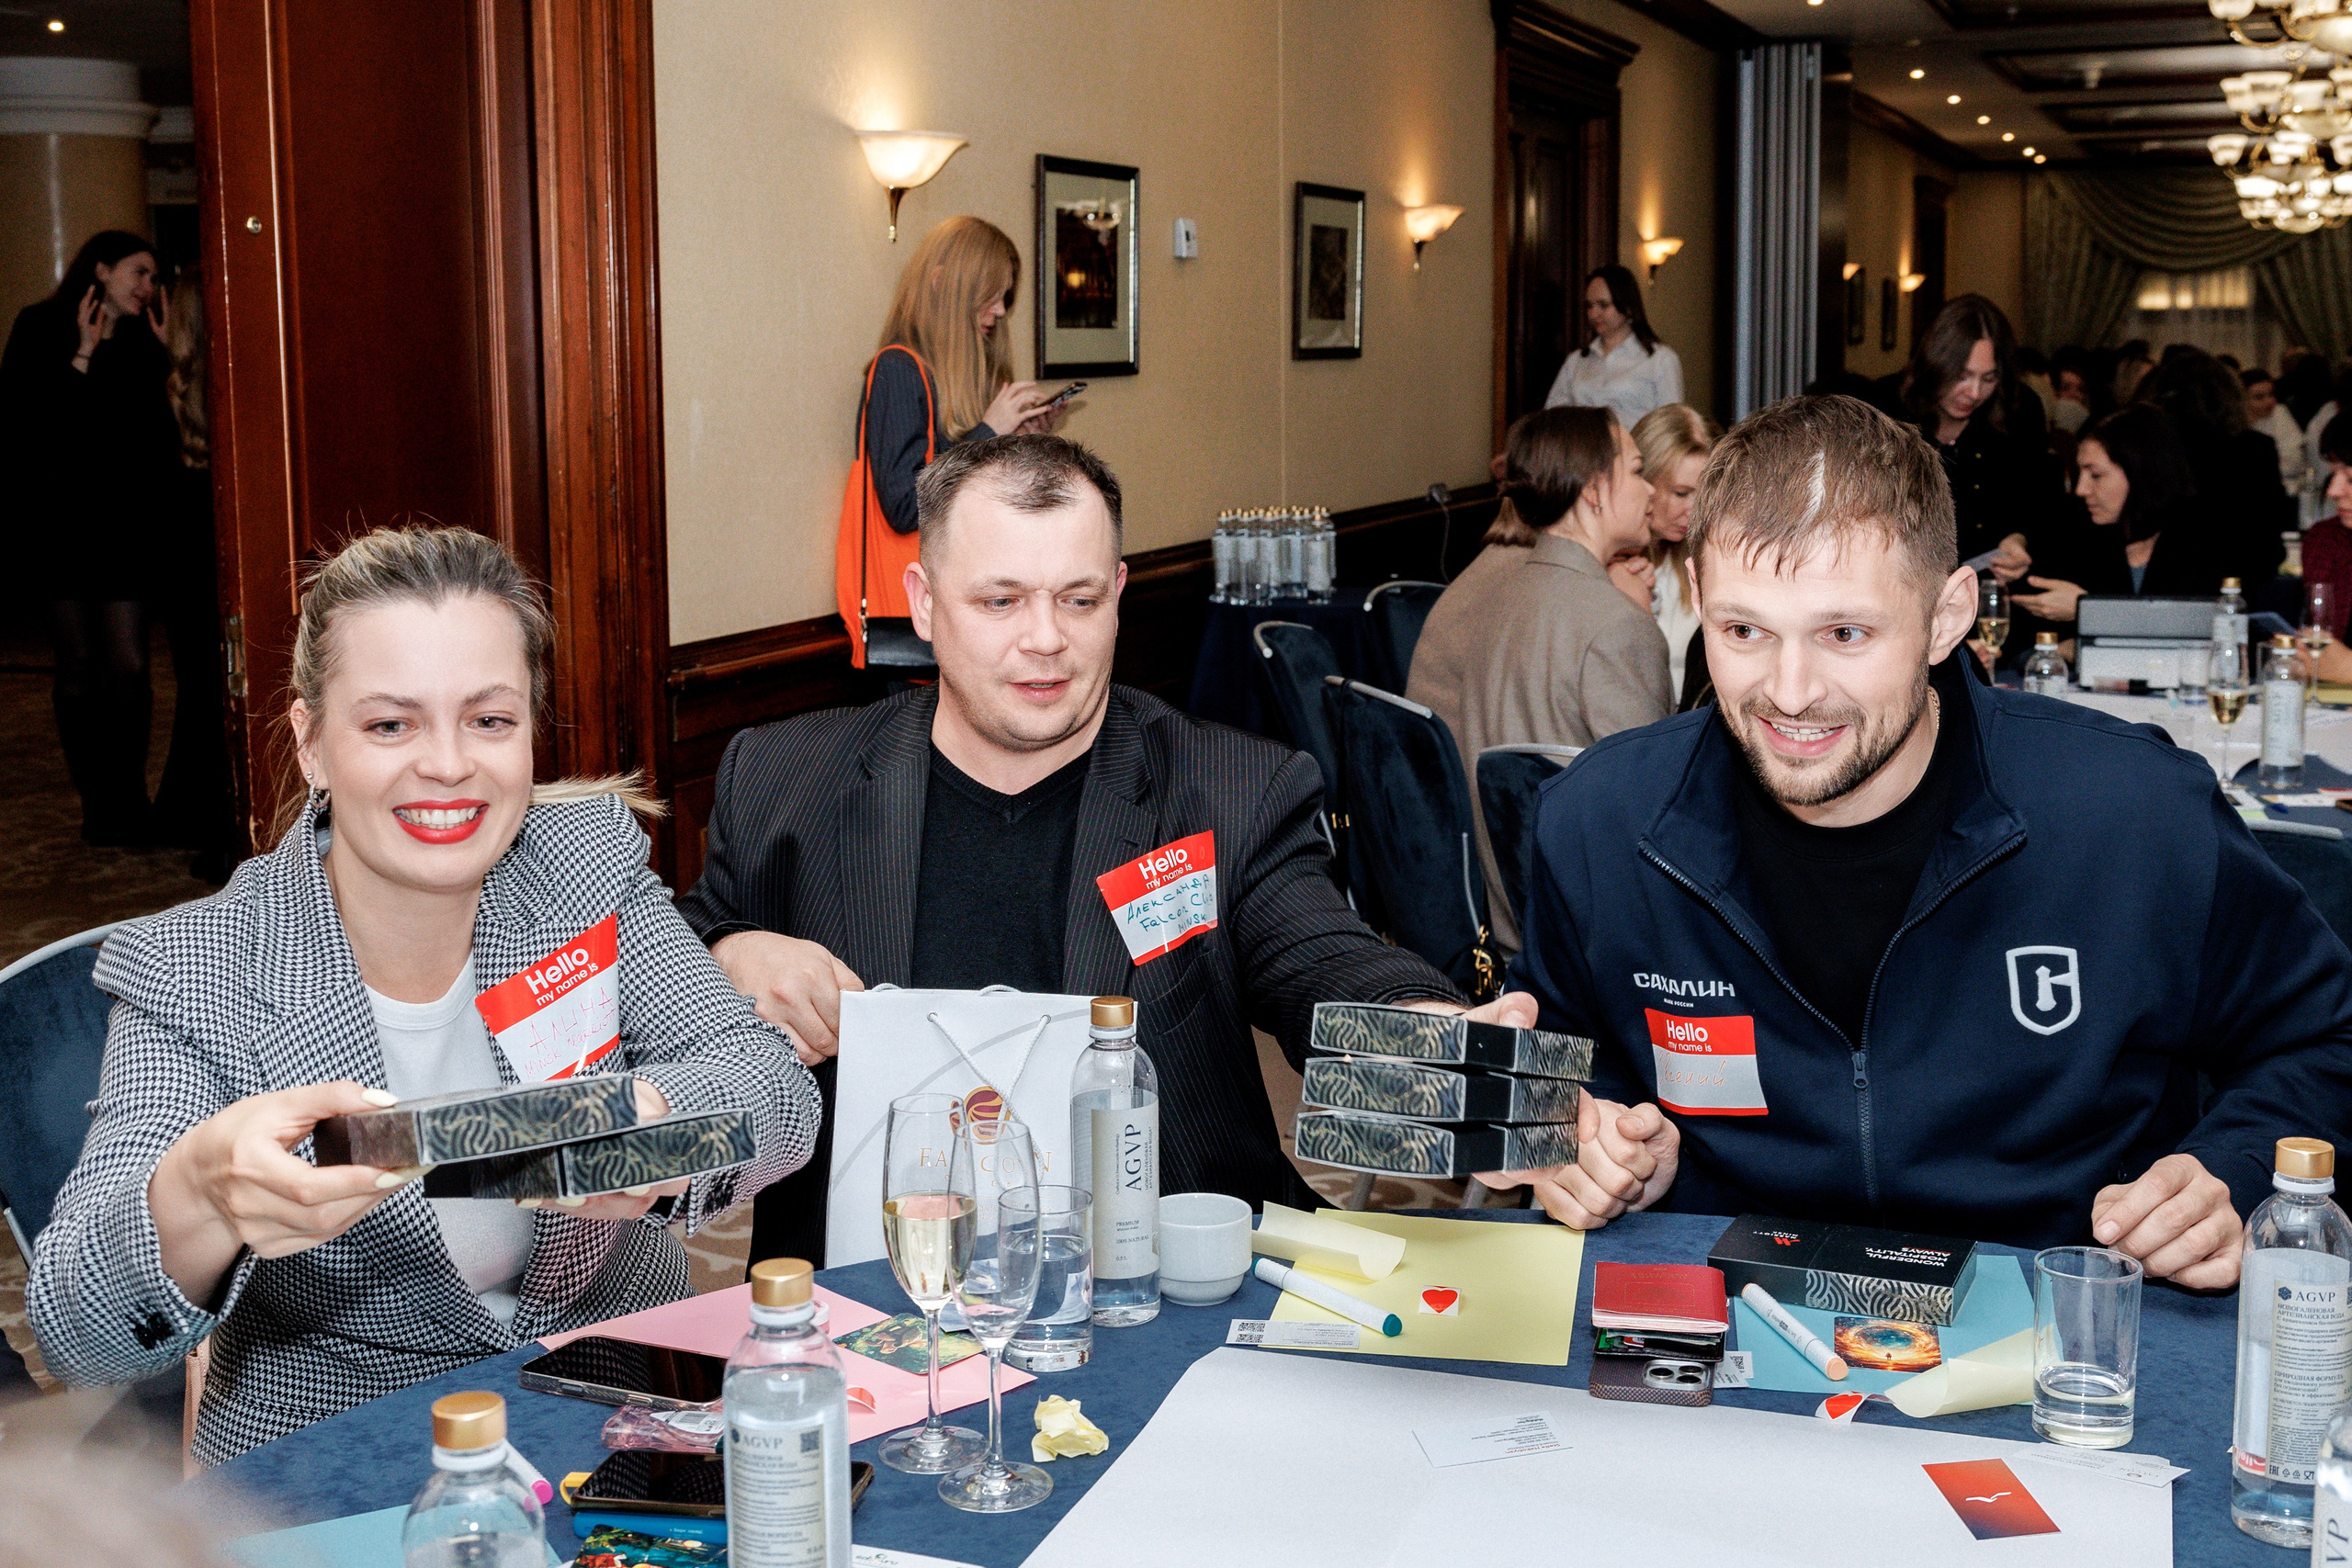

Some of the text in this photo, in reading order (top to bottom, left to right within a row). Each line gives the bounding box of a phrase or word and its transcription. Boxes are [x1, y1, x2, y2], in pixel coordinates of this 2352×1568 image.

[1138, 849, 1188, 880] Hello
[1146, 863, 1193, 890] my name is
[1178, 913, 1206, 933] MINSK
[525, 948, 589, 995] Hello
[536, 962, 599, 1007] my name is
[1633, 973, 1736, 997] САХАЛИН
[1666, 1020, 1708, 1042] Hello
[1668, 1041, 1712, 1052] my name is
[920, 1148, 1052, 1173] FACON
[1125, 1124, 1142, 1190] AGVP
[1866, 1252, 1945, 1267] WONDERFUL
[1902, 1247, 1951, 1257] ALWAYS
[2296, 1292, 2335, 1302] AGVP
[2277, 1310, 2329, 1319] АРТЕЗИАНСКАЯ
[2278, 1303, 2335, 1313] НОВОГАЛЕНОВАЯ
[2274, 1371, 2314, 1381] ПРИРОДНАЯ
[743, 1435, 783, 1449] AGVP
